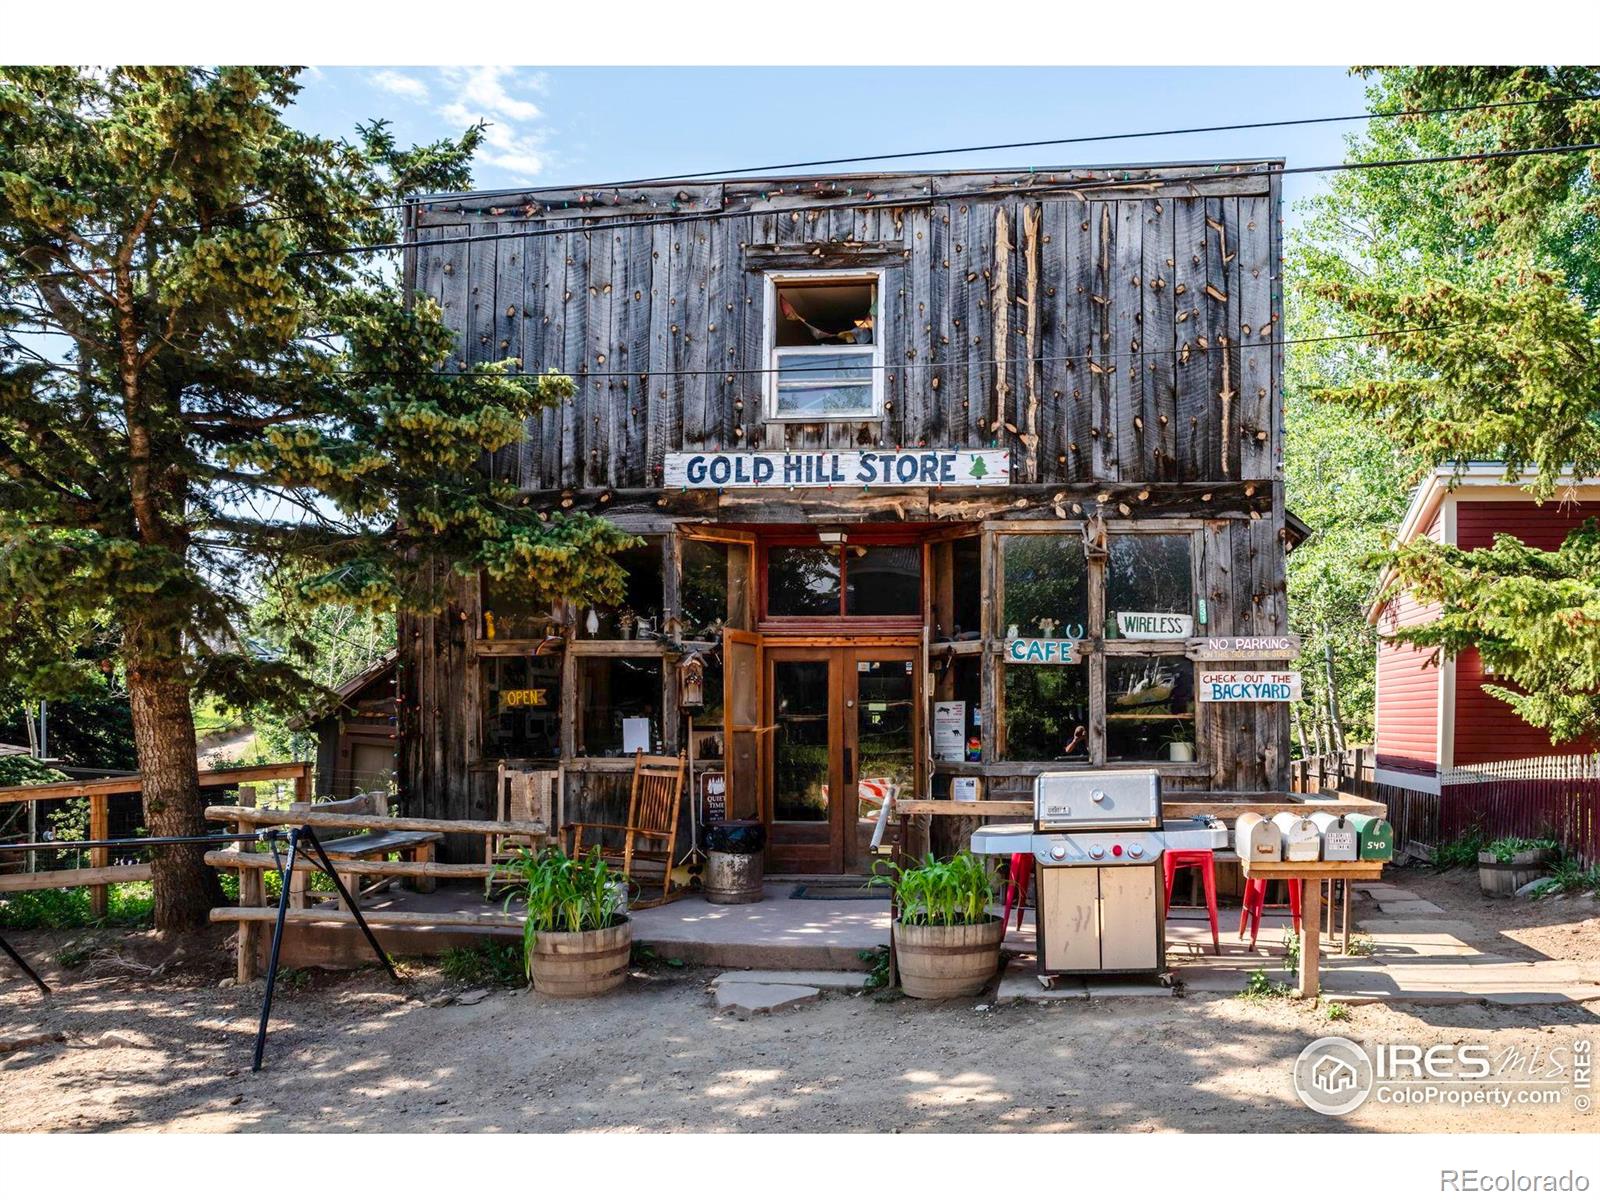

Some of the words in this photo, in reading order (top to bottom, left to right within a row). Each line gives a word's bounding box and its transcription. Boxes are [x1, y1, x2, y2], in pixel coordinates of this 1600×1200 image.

[686, 455, 774, 484] GOLD
[784, 454, 845, 483] HILL
[856, 453, 957, 483] STORE
[1124, 616, 1183, 634] WIRELESS
[1010, 640, 1073, 662] CAFE
[1209, 638, 1228, 650] NO
[1235, 638, 1290, 650] PARKING
[1202, 674, 1237, 684] CHECK
[1244, 674, 1265, 683] OUT
[1271, 674, 1291, 683] THE
[507, 690, 538, 705] OPEN
[1212, 683, 1291, 700] BACKYARD
